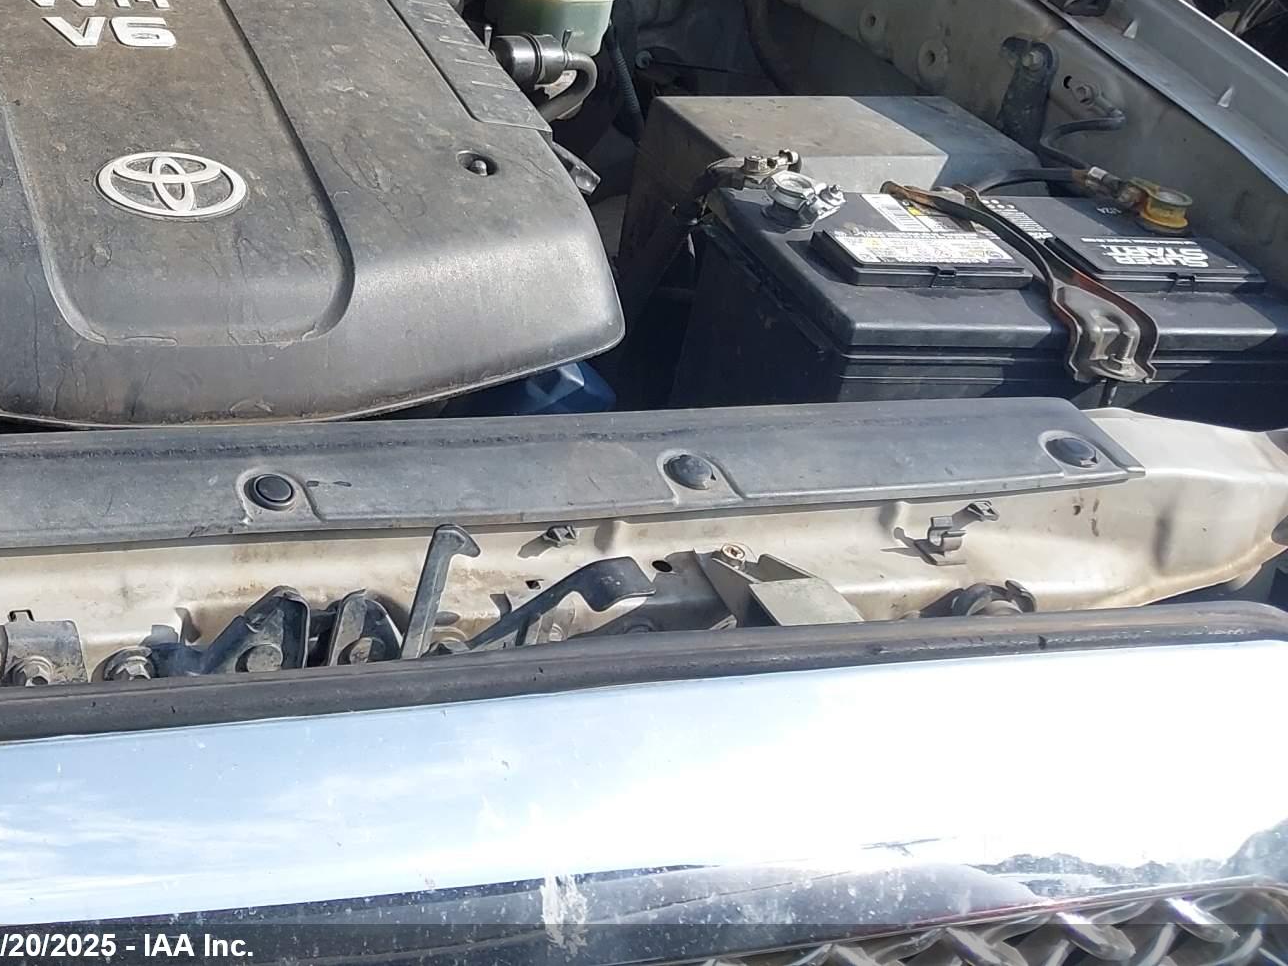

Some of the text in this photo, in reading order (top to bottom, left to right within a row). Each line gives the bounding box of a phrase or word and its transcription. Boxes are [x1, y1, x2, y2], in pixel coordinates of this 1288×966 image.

[42, 16, 177, 48] V6
[1107, 246, 1209, 260] START
[1113, 256, 1209, 268] SUPER
